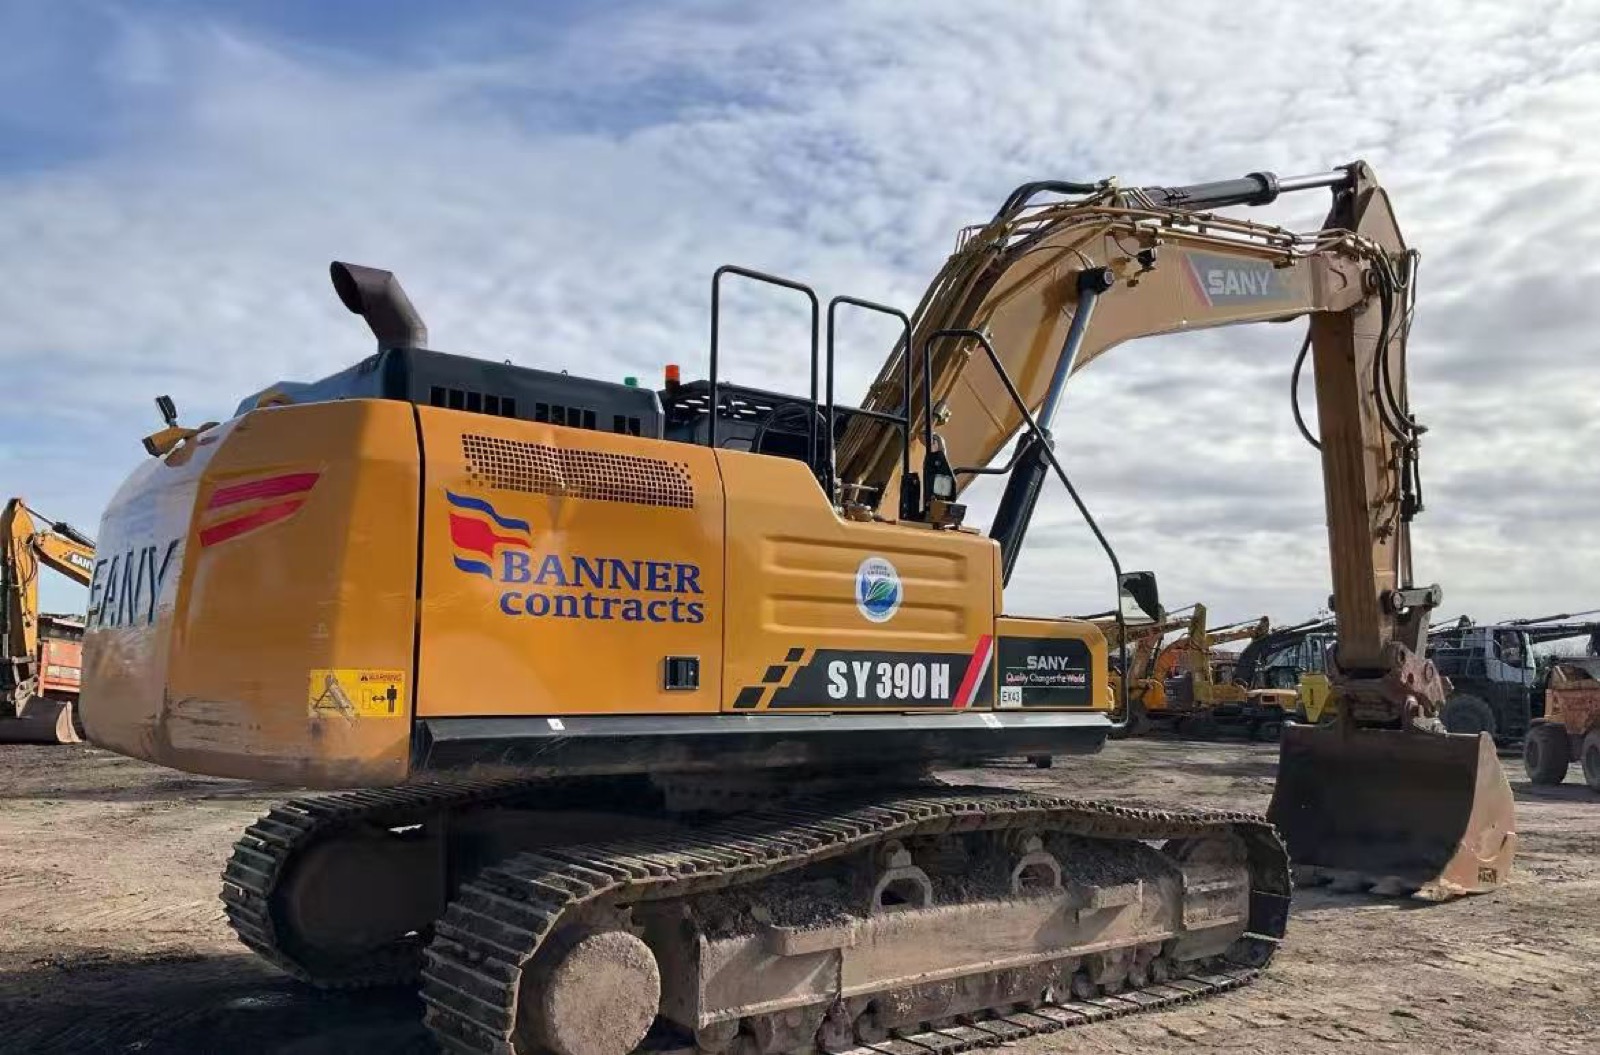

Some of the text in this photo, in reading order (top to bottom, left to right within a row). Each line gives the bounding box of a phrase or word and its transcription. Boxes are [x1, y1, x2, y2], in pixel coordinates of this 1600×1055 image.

[1208, 269, 1270, 295] SANY
[500, 551, 704, 593] BANNER
[500, 591, 704, 623] contracts
[1026, 655, 1069, 670] SANY
